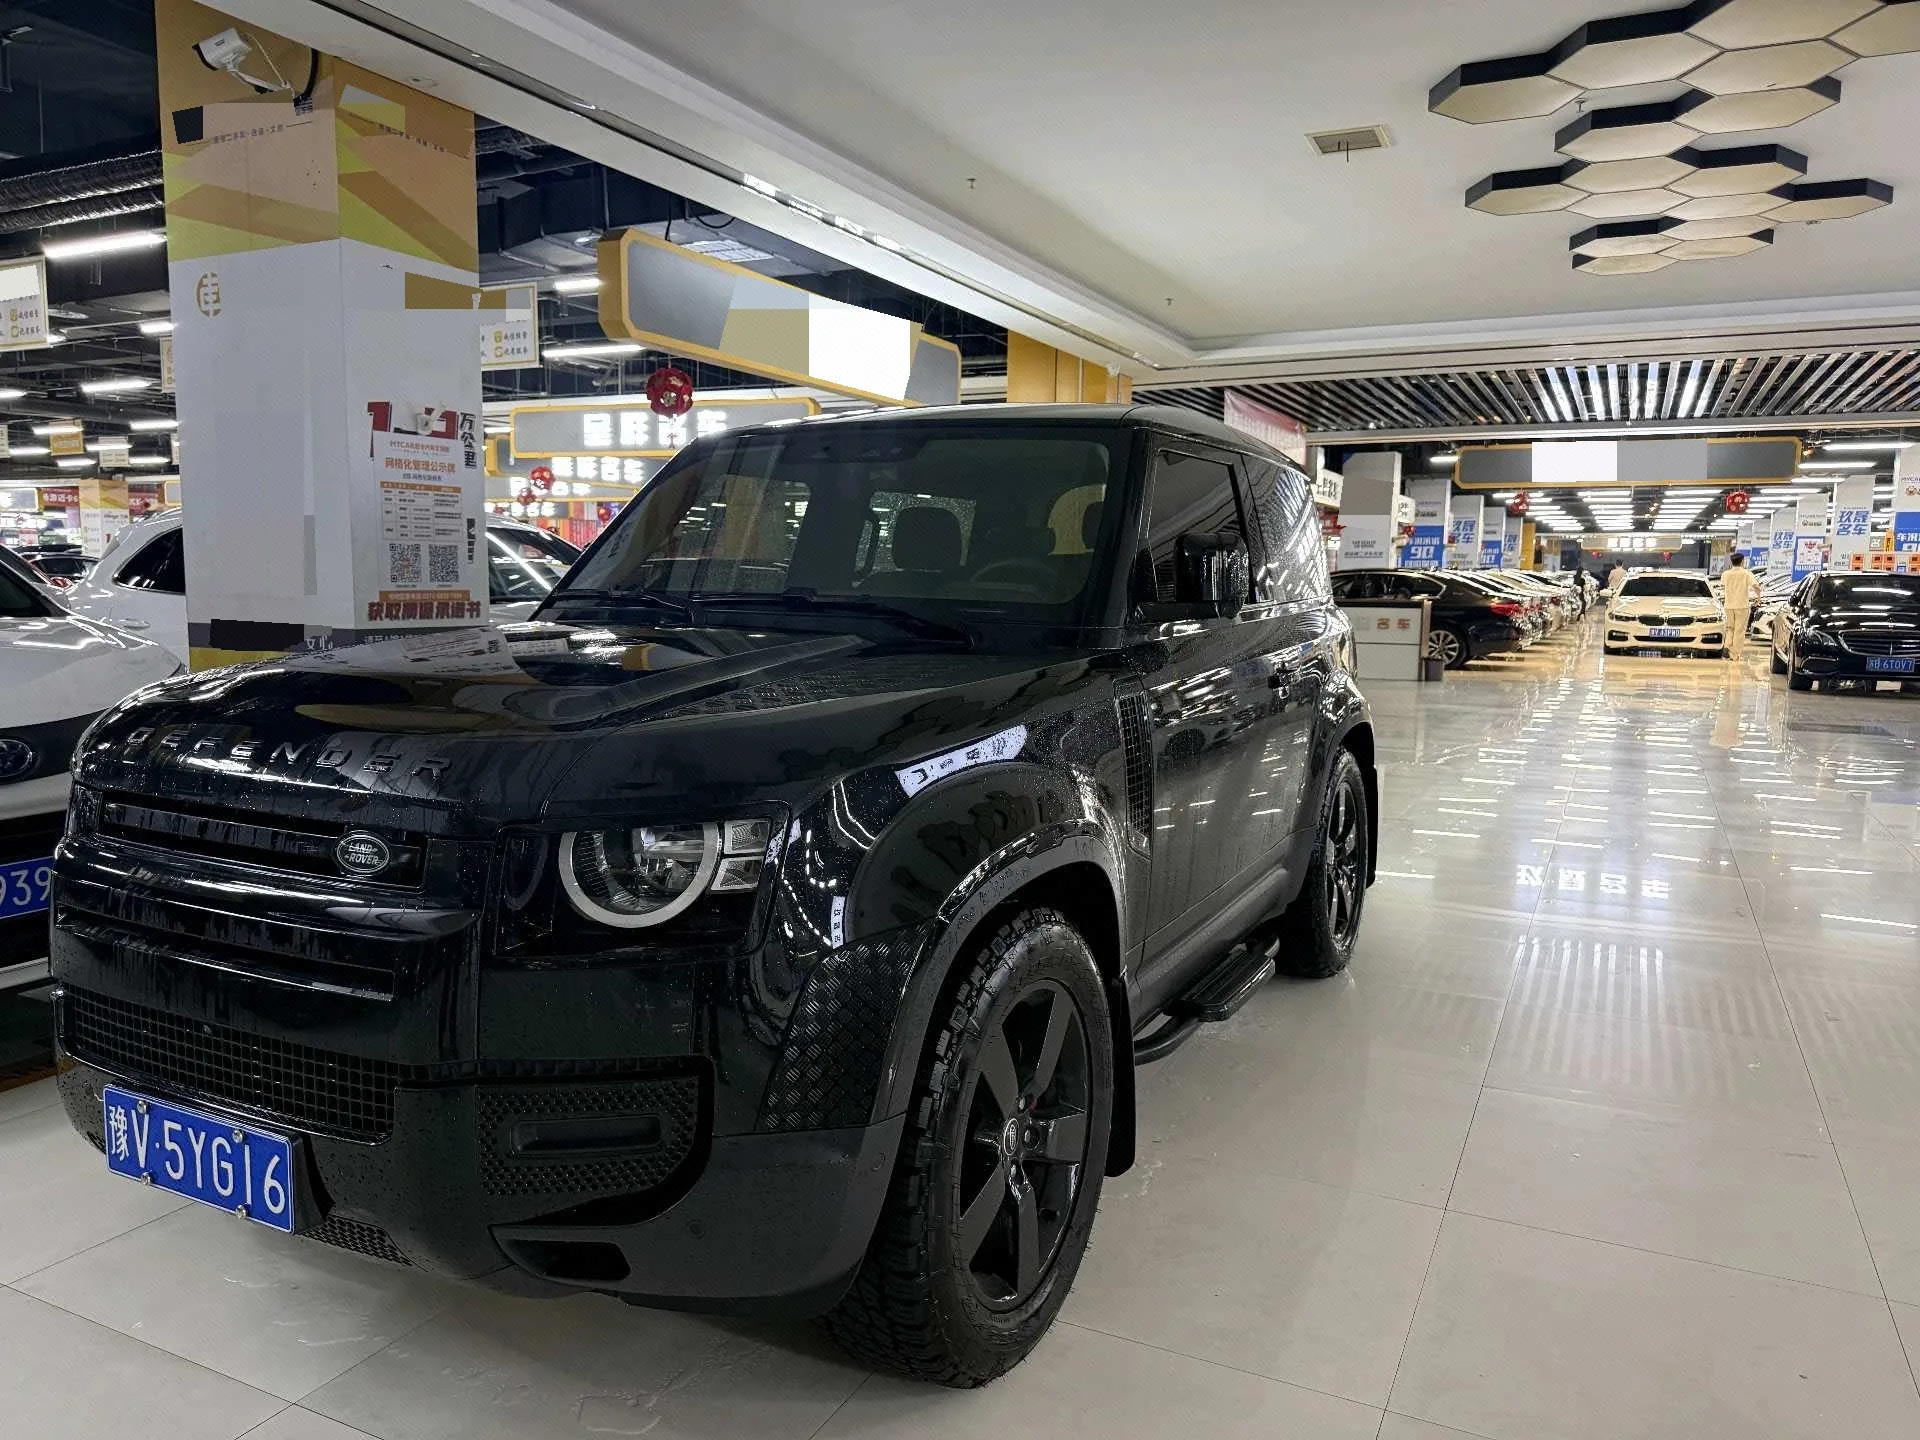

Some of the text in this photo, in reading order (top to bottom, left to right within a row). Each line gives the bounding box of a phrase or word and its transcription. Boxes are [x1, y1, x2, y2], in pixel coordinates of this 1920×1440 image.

[1836, 523, 1868, 536] 名车
[127, 727, 451, 781] DEFENDER
[349, 842, 373, 854] LAND
[349, 852, 379, 865] ROVER
[108, 1104, 286, 1215] 豫V·5YG16
